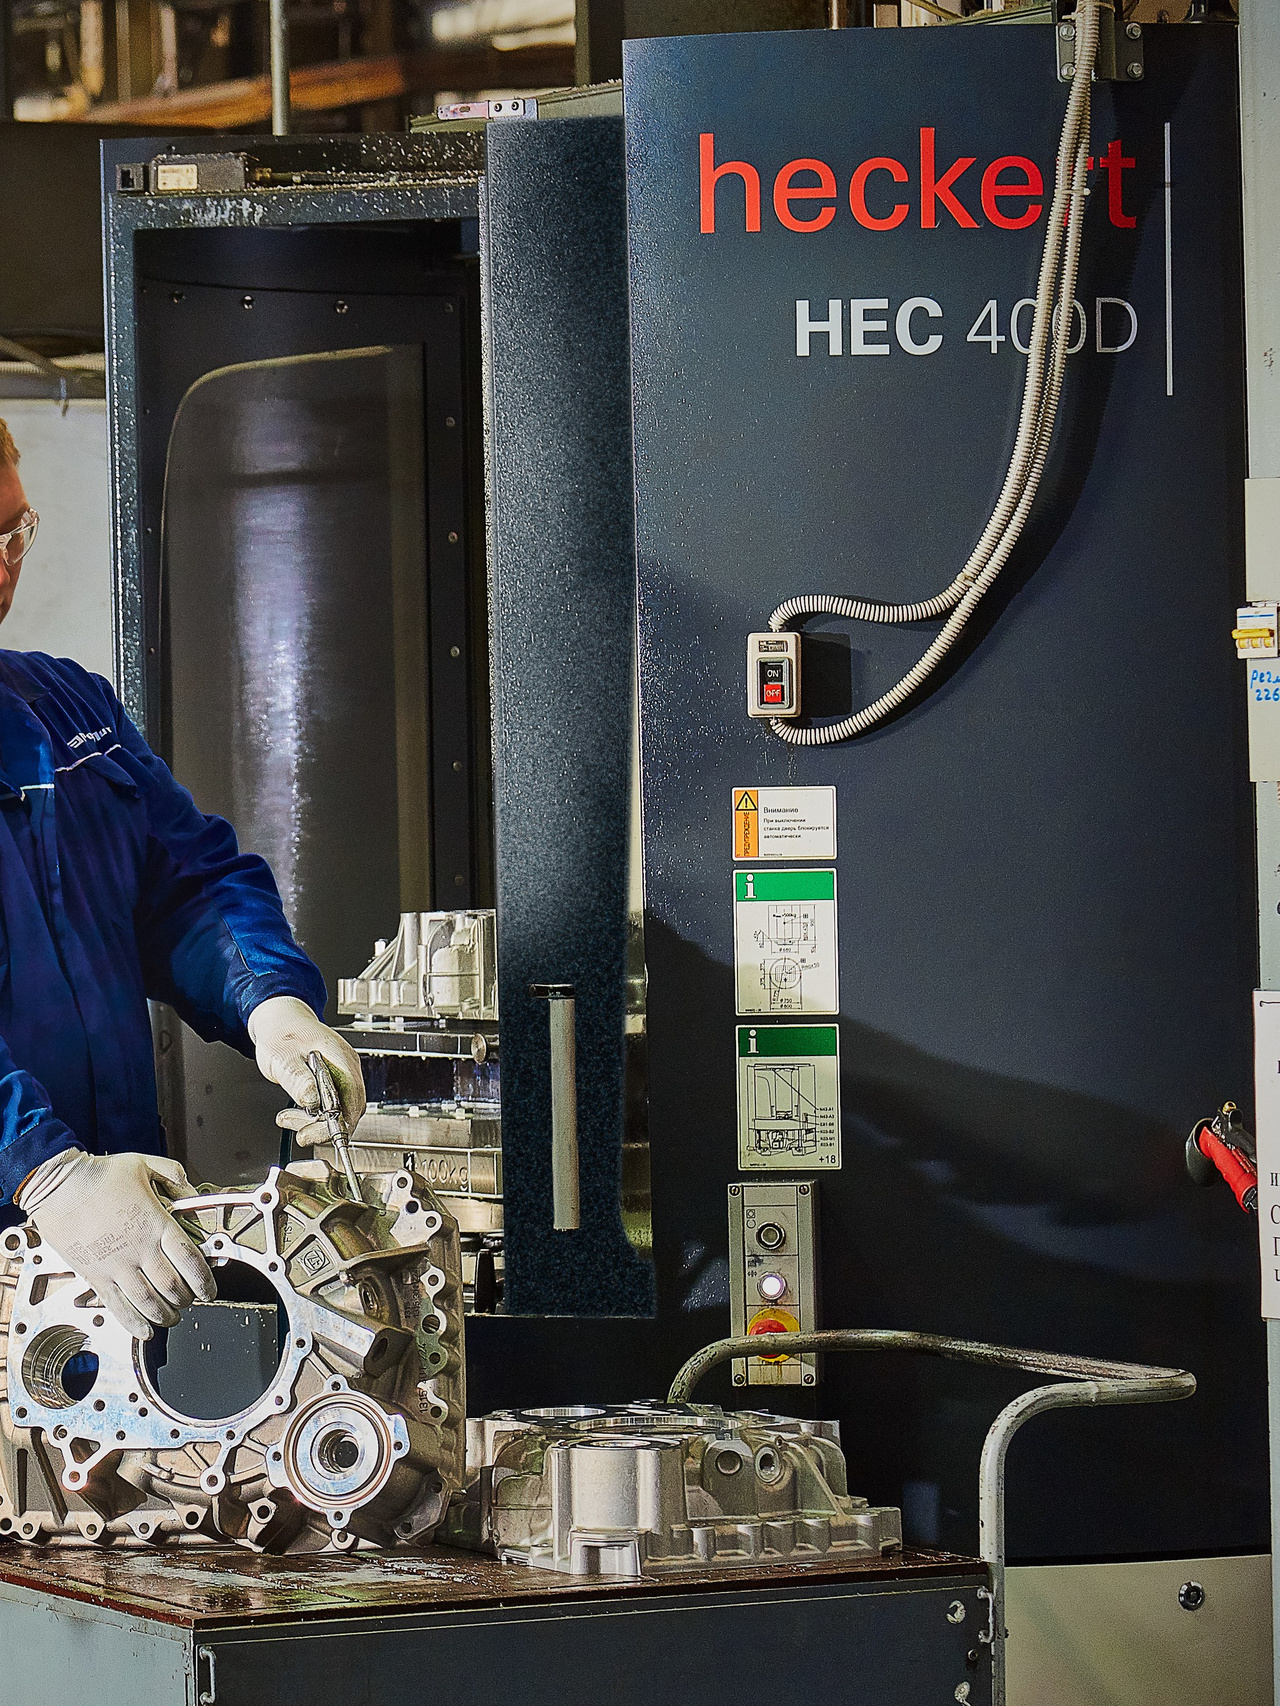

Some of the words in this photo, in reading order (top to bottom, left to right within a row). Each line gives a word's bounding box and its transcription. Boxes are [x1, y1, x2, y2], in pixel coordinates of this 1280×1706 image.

[699, 127, 1137, 234] hecket
[795, 297, 944, 357] HEC
[966, 297, 1138, 354] 400D
[767, 669, 779, 678] ON
[766, 689, 780, 697] OFF
[818, 1154, 836, 1164] +18
